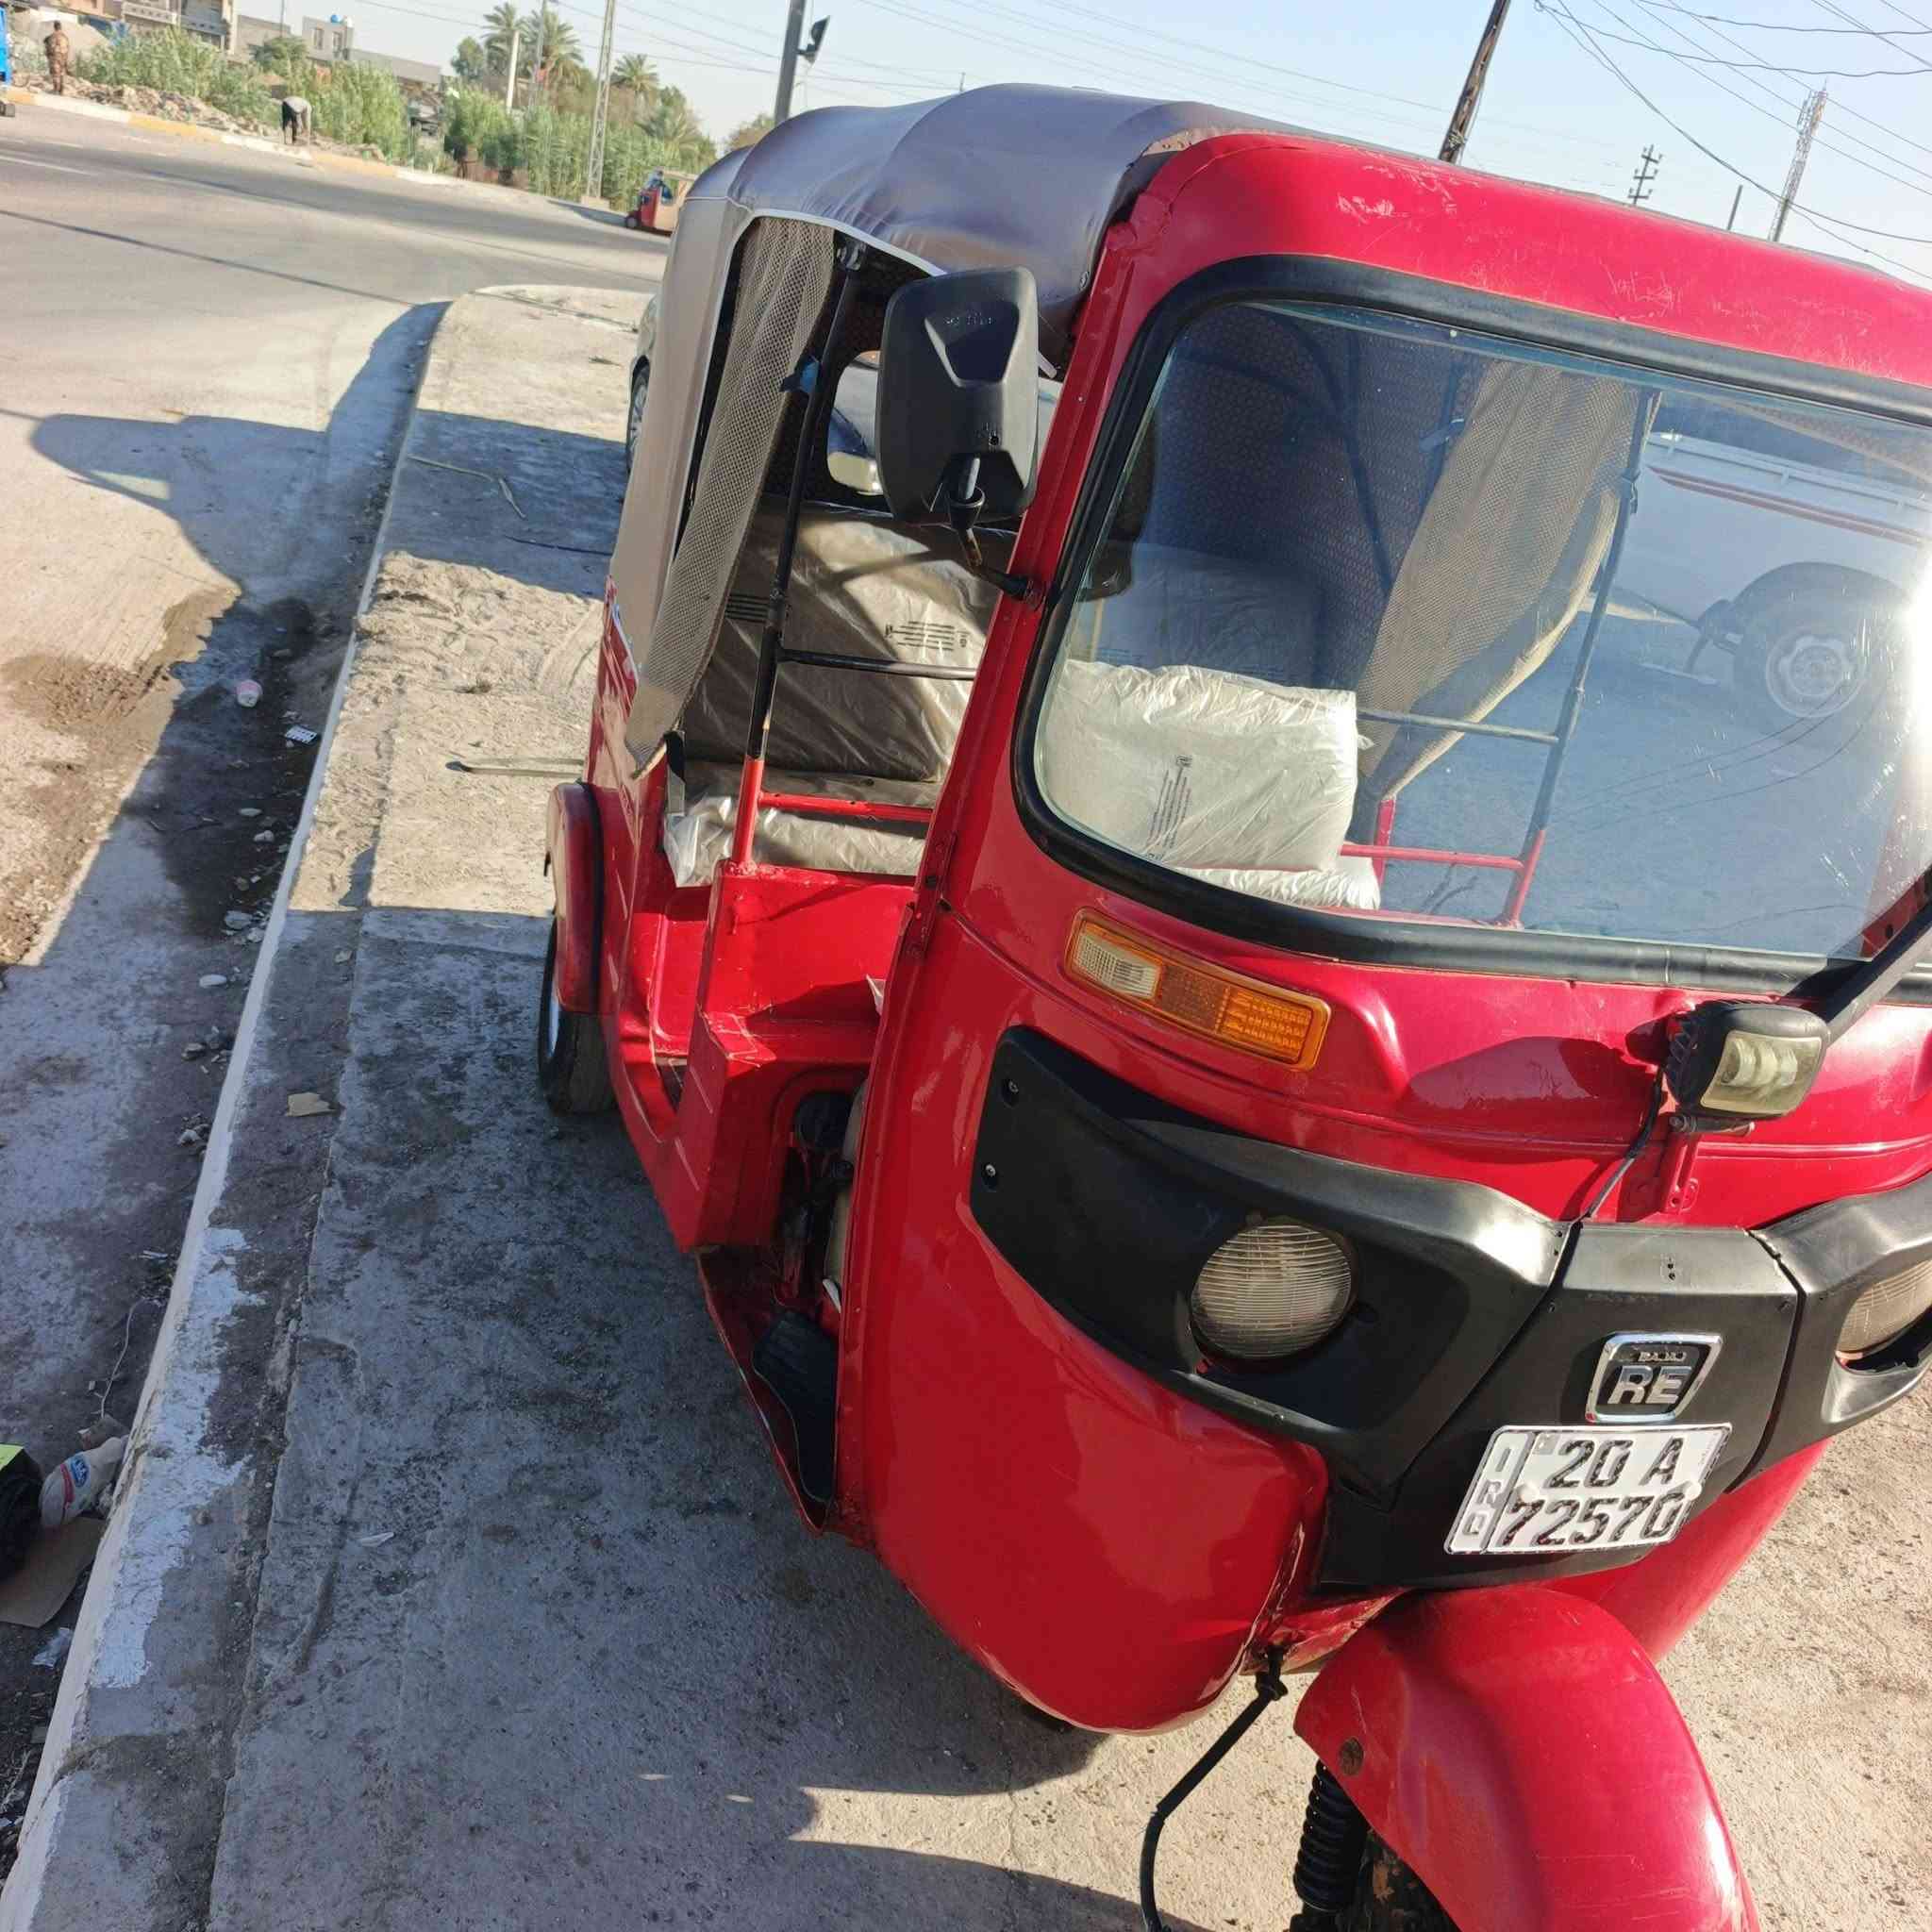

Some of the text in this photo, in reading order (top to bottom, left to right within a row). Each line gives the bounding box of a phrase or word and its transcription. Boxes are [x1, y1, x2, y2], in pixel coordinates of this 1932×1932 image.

[1607, 1365, 1691, 1404] RE
[1544, 1439, 1634, 1489] 20
[1640, 1436, 1683, 1486] A
[1495, 1492, 1685, 1546] 72570
